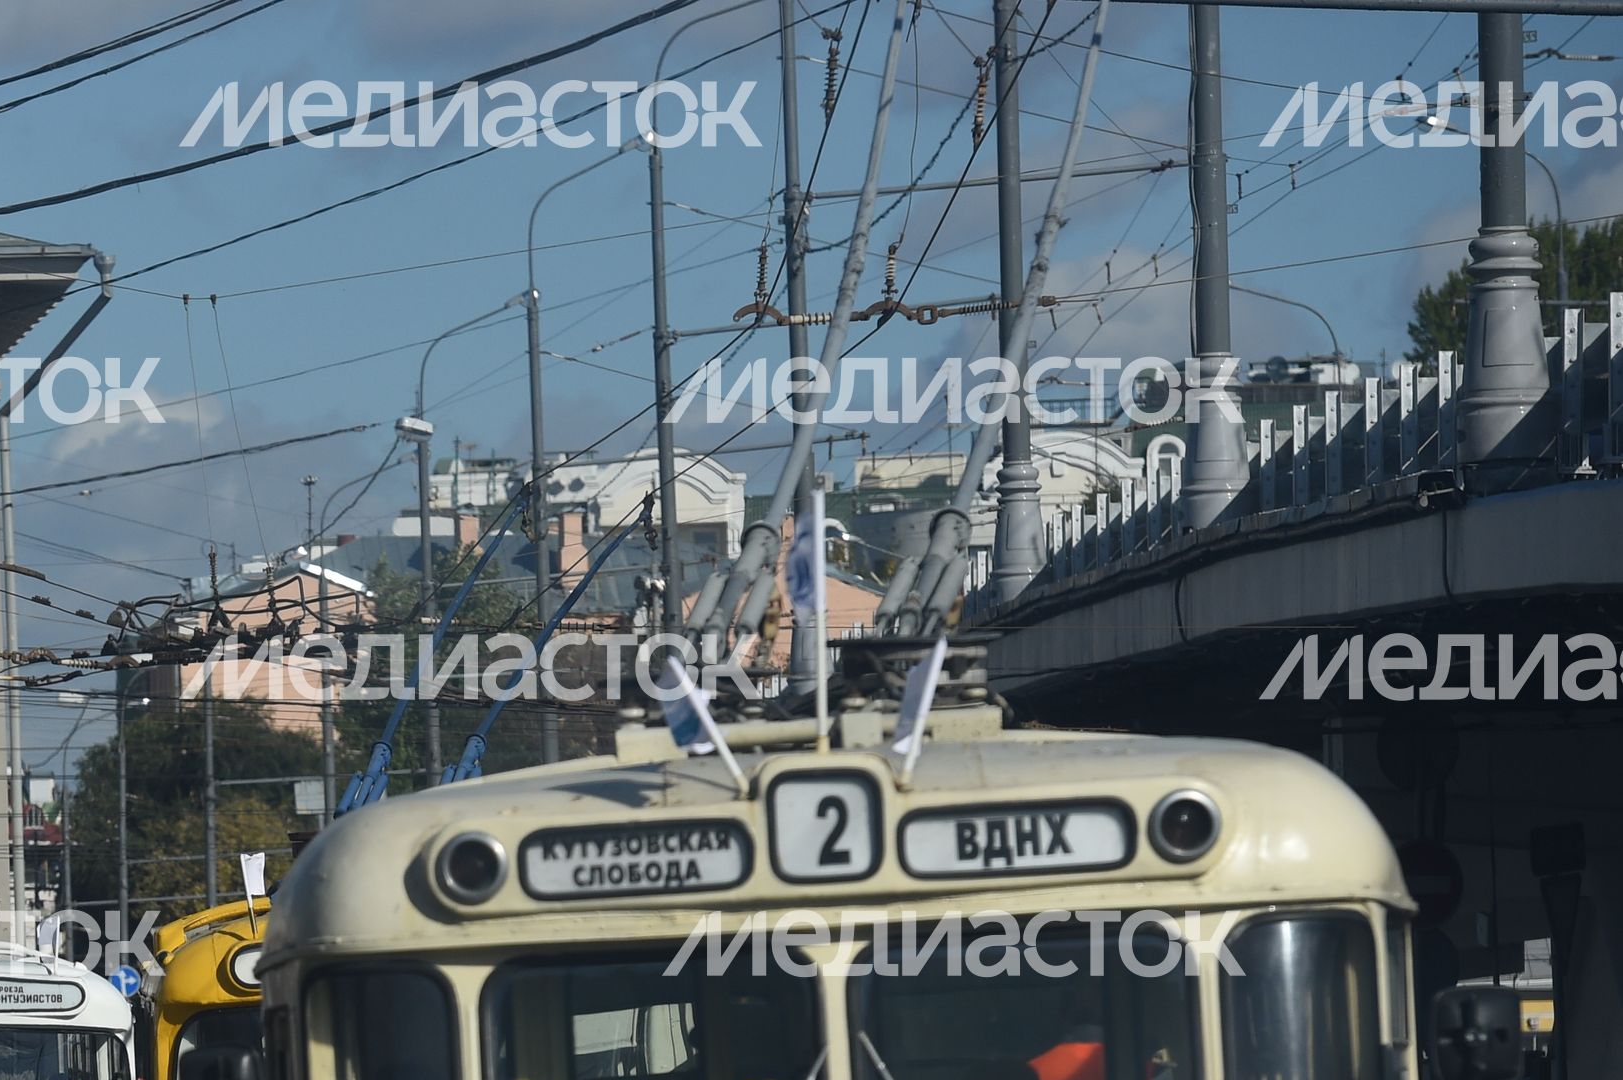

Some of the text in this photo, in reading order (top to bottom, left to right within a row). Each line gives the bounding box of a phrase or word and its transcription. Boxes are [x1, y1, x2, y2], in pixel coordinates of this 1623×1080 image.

[541, 830, 732, 861] КУТУЗОВСКАЯ
[814, 795, 852, 867] 2
[955, 814, 1073, 868] ВДНХ
[572, 860, 703, 889] СЛОБОДА
